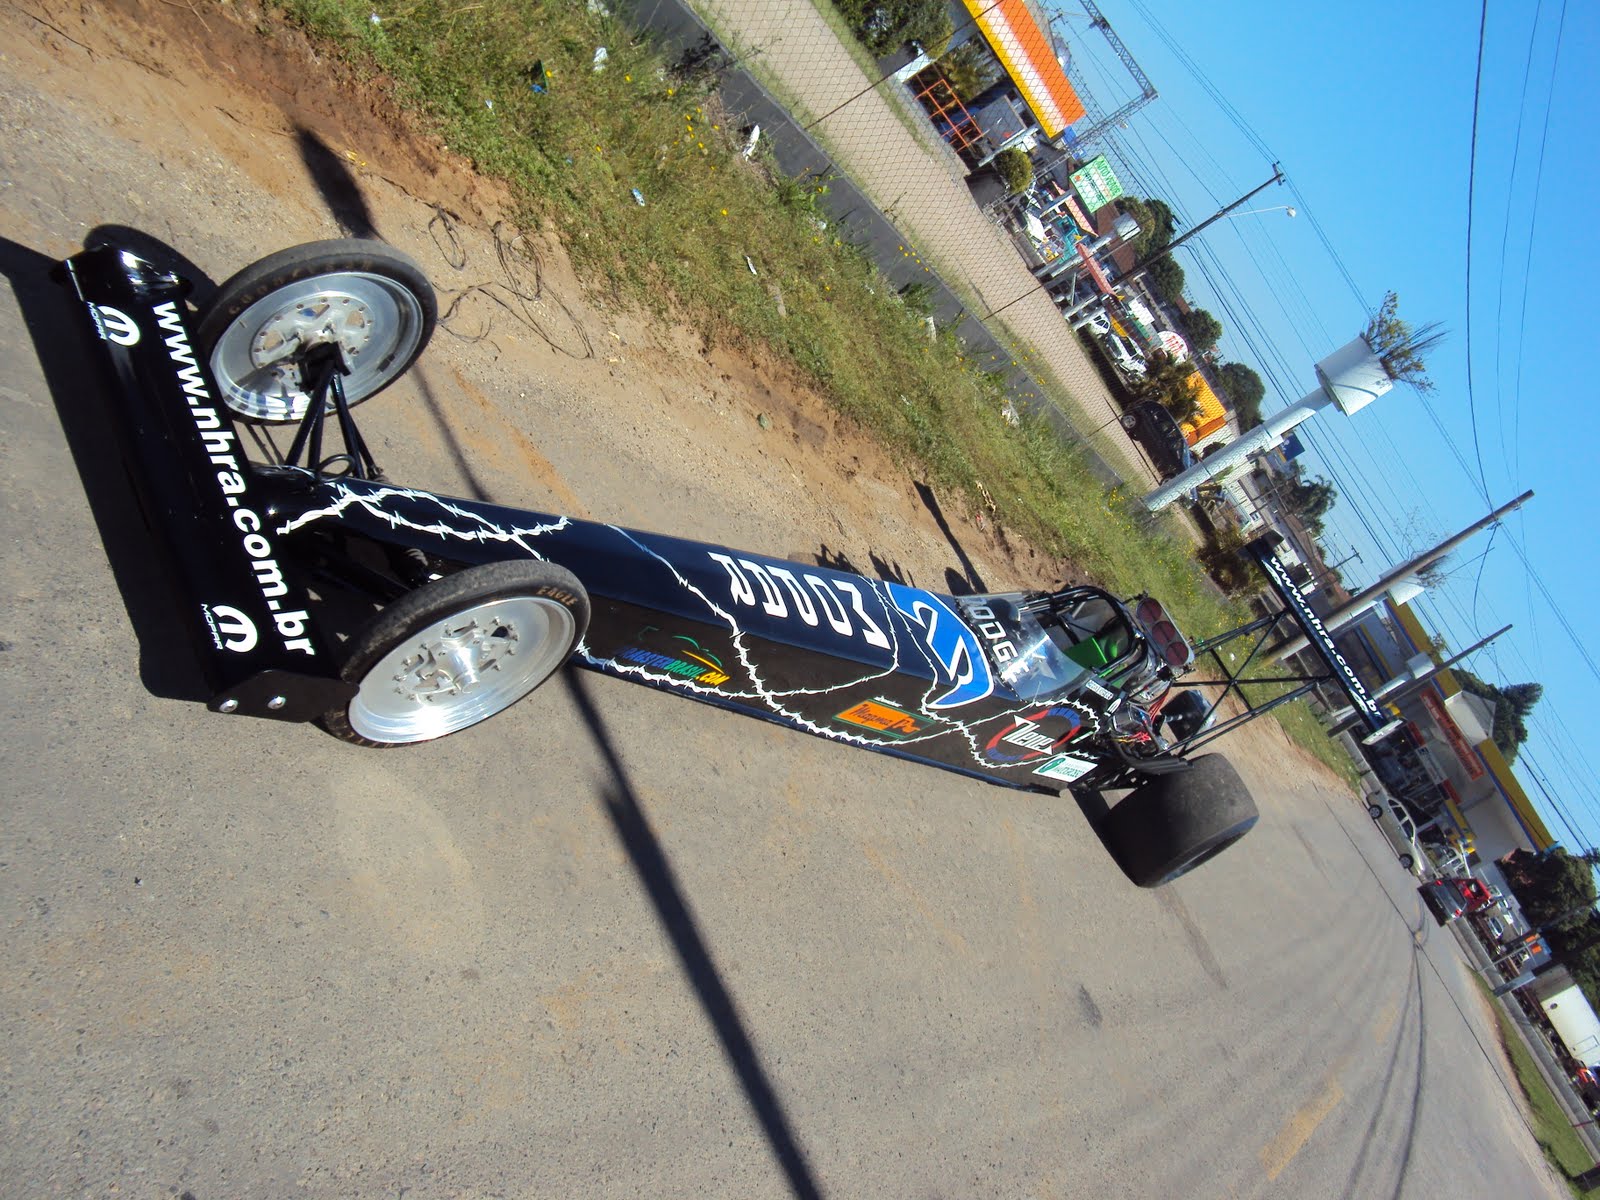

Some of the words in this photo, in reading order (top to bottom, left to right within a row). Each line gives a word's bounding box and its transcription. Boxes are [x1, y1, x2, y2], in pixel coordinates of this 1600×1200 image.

[87, 301, 107, 340] MOPAR
[152, 301, 315, 656] www.nhra.com.br
[200, 603, 224, 650] MOPAR
[1270, 556, 1384, 719] www.nhra.com.br
